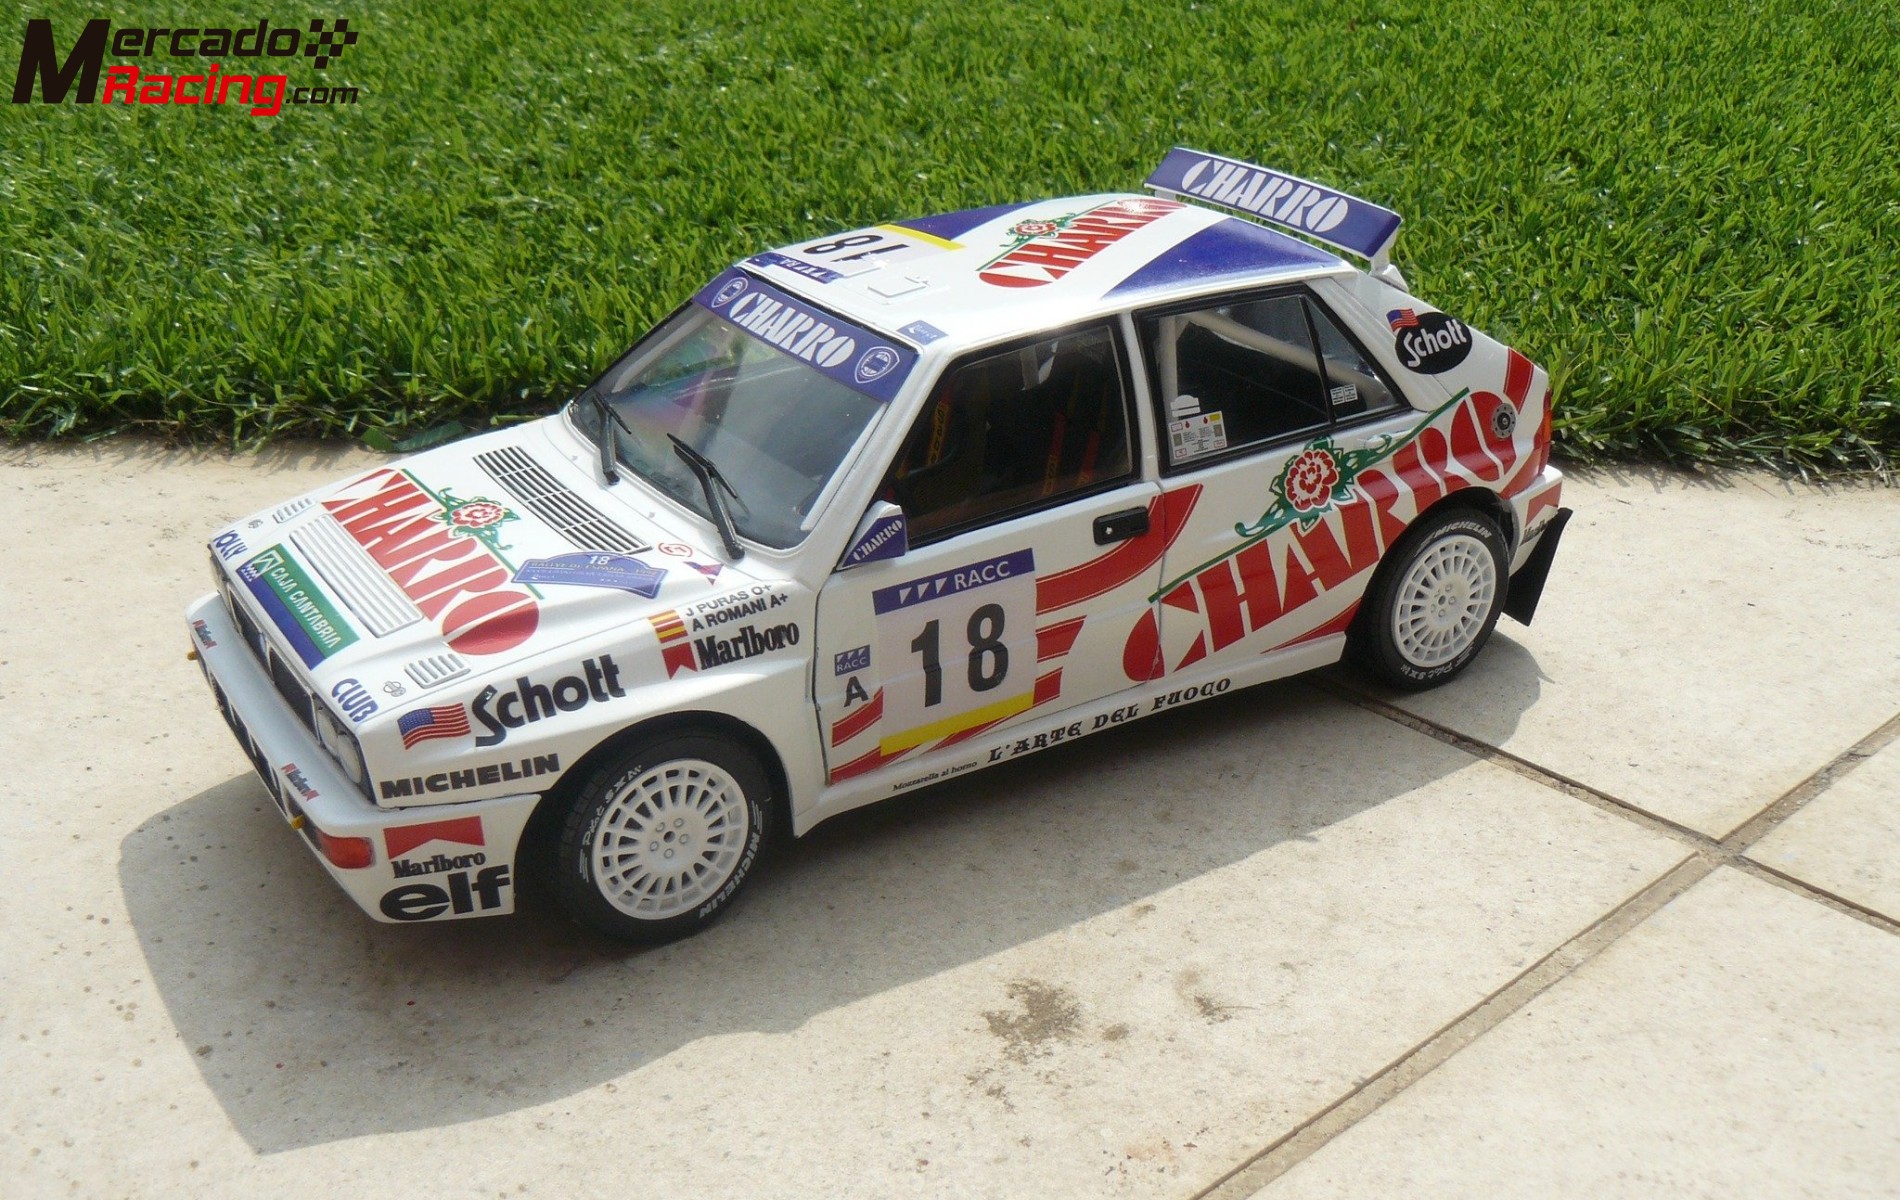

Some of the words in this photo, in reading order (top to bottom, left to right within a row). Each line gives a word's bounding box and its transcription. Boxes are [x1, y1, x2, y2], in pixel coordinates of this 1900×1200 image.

[1181, 159, 1349, 233] CHARRO
[729, 291, 856, 368] CHARRO
[1403, 319, 1467, 367] Schott
[213, 530, 248, 561] JOLLY
[853, 519, 903, 561] CHARRO
[1123, 391, 1518, 683] CHARRO
[1434, 519, 1493, 539] MICHELIN
[320, 467, 540, 656] CHARRO
[589, 554, 610, 566] 18
[954, 561, 1011, 590] RACC
[271, 567, 298, 593] CAJA
[289, 590, 342, 649] CANTABRIA
[686, 608, 694, 617] J
[696, 590, 750, 613] PURAS
[692, 618, 704, 632] A
[705, 598, 767, 627] ROMANI
[770, 593, 788, 609] A+
[694, 622, 800, 671] Marlboro
[836, 656, 867, 673] RACC
[911, 603, 1009, 707] 18
[331, 678, 379, 723] CLUB
[471, 653, 627, 747] Schott
[844, 676, 869, 708] A
[986, 720, 1083, 763] L'ARTE
[1092, 704, 1139, 730] DEL
[1151, 677, 1232, 712] FUOCO
[379, 753, 561, 800] MICHELIN
[892, 772, 939, 792] Mozzarella
[940, 767, 949, 777] al
[391, 851, 486, 879] Marlboro
[699, 832, 761, 919] MICHELIN
[379, 864, 511, 922] elf
